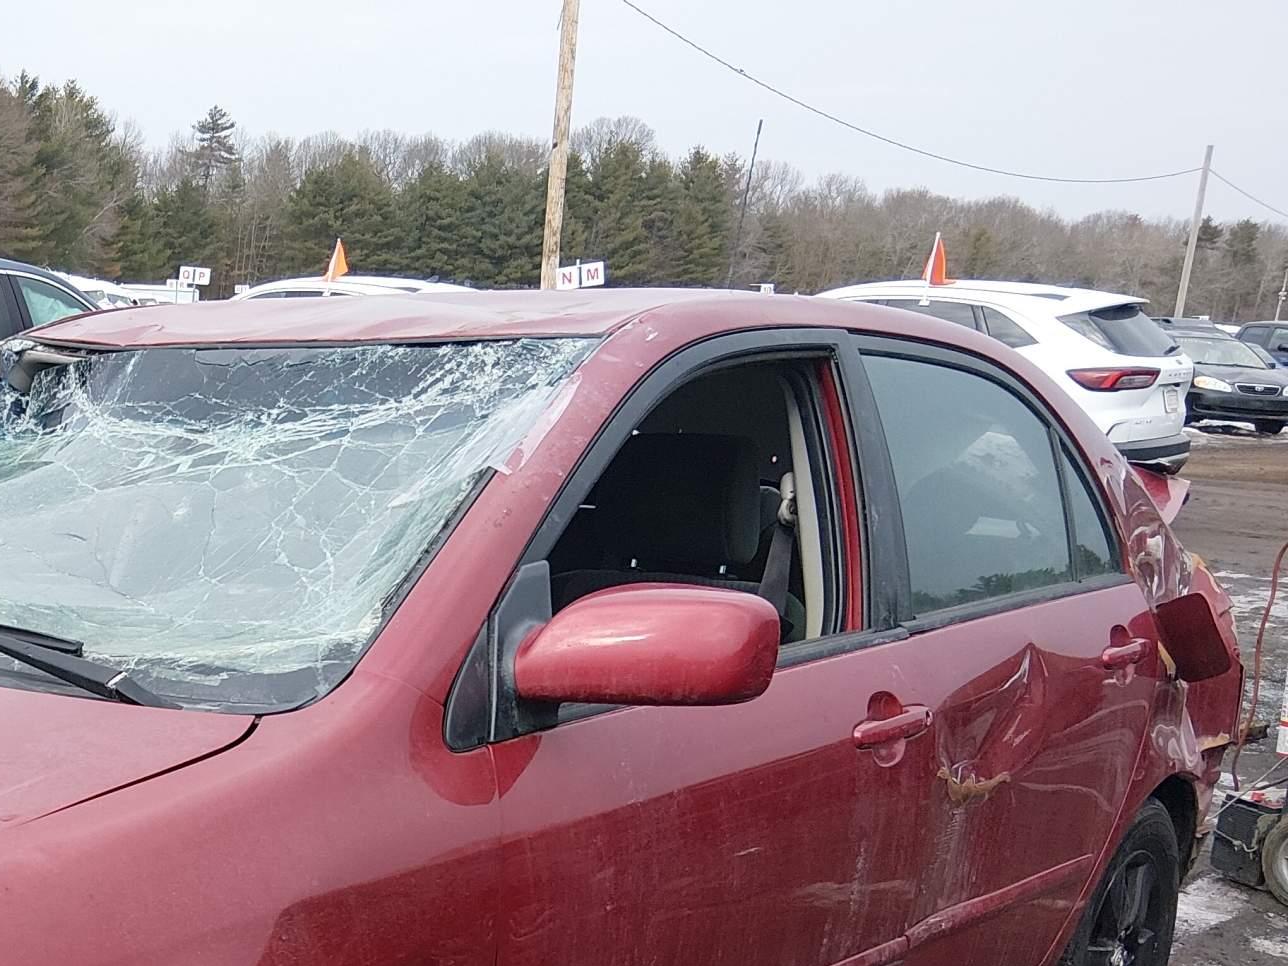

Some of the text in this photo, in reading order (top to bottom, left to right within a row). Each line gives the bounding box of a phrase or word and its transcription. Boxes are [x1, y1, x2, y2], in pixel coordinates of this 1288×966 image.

[199, 271, 206, 281] P
[562, 271, 572, 285] N
[586, 268, 599, 281] M
